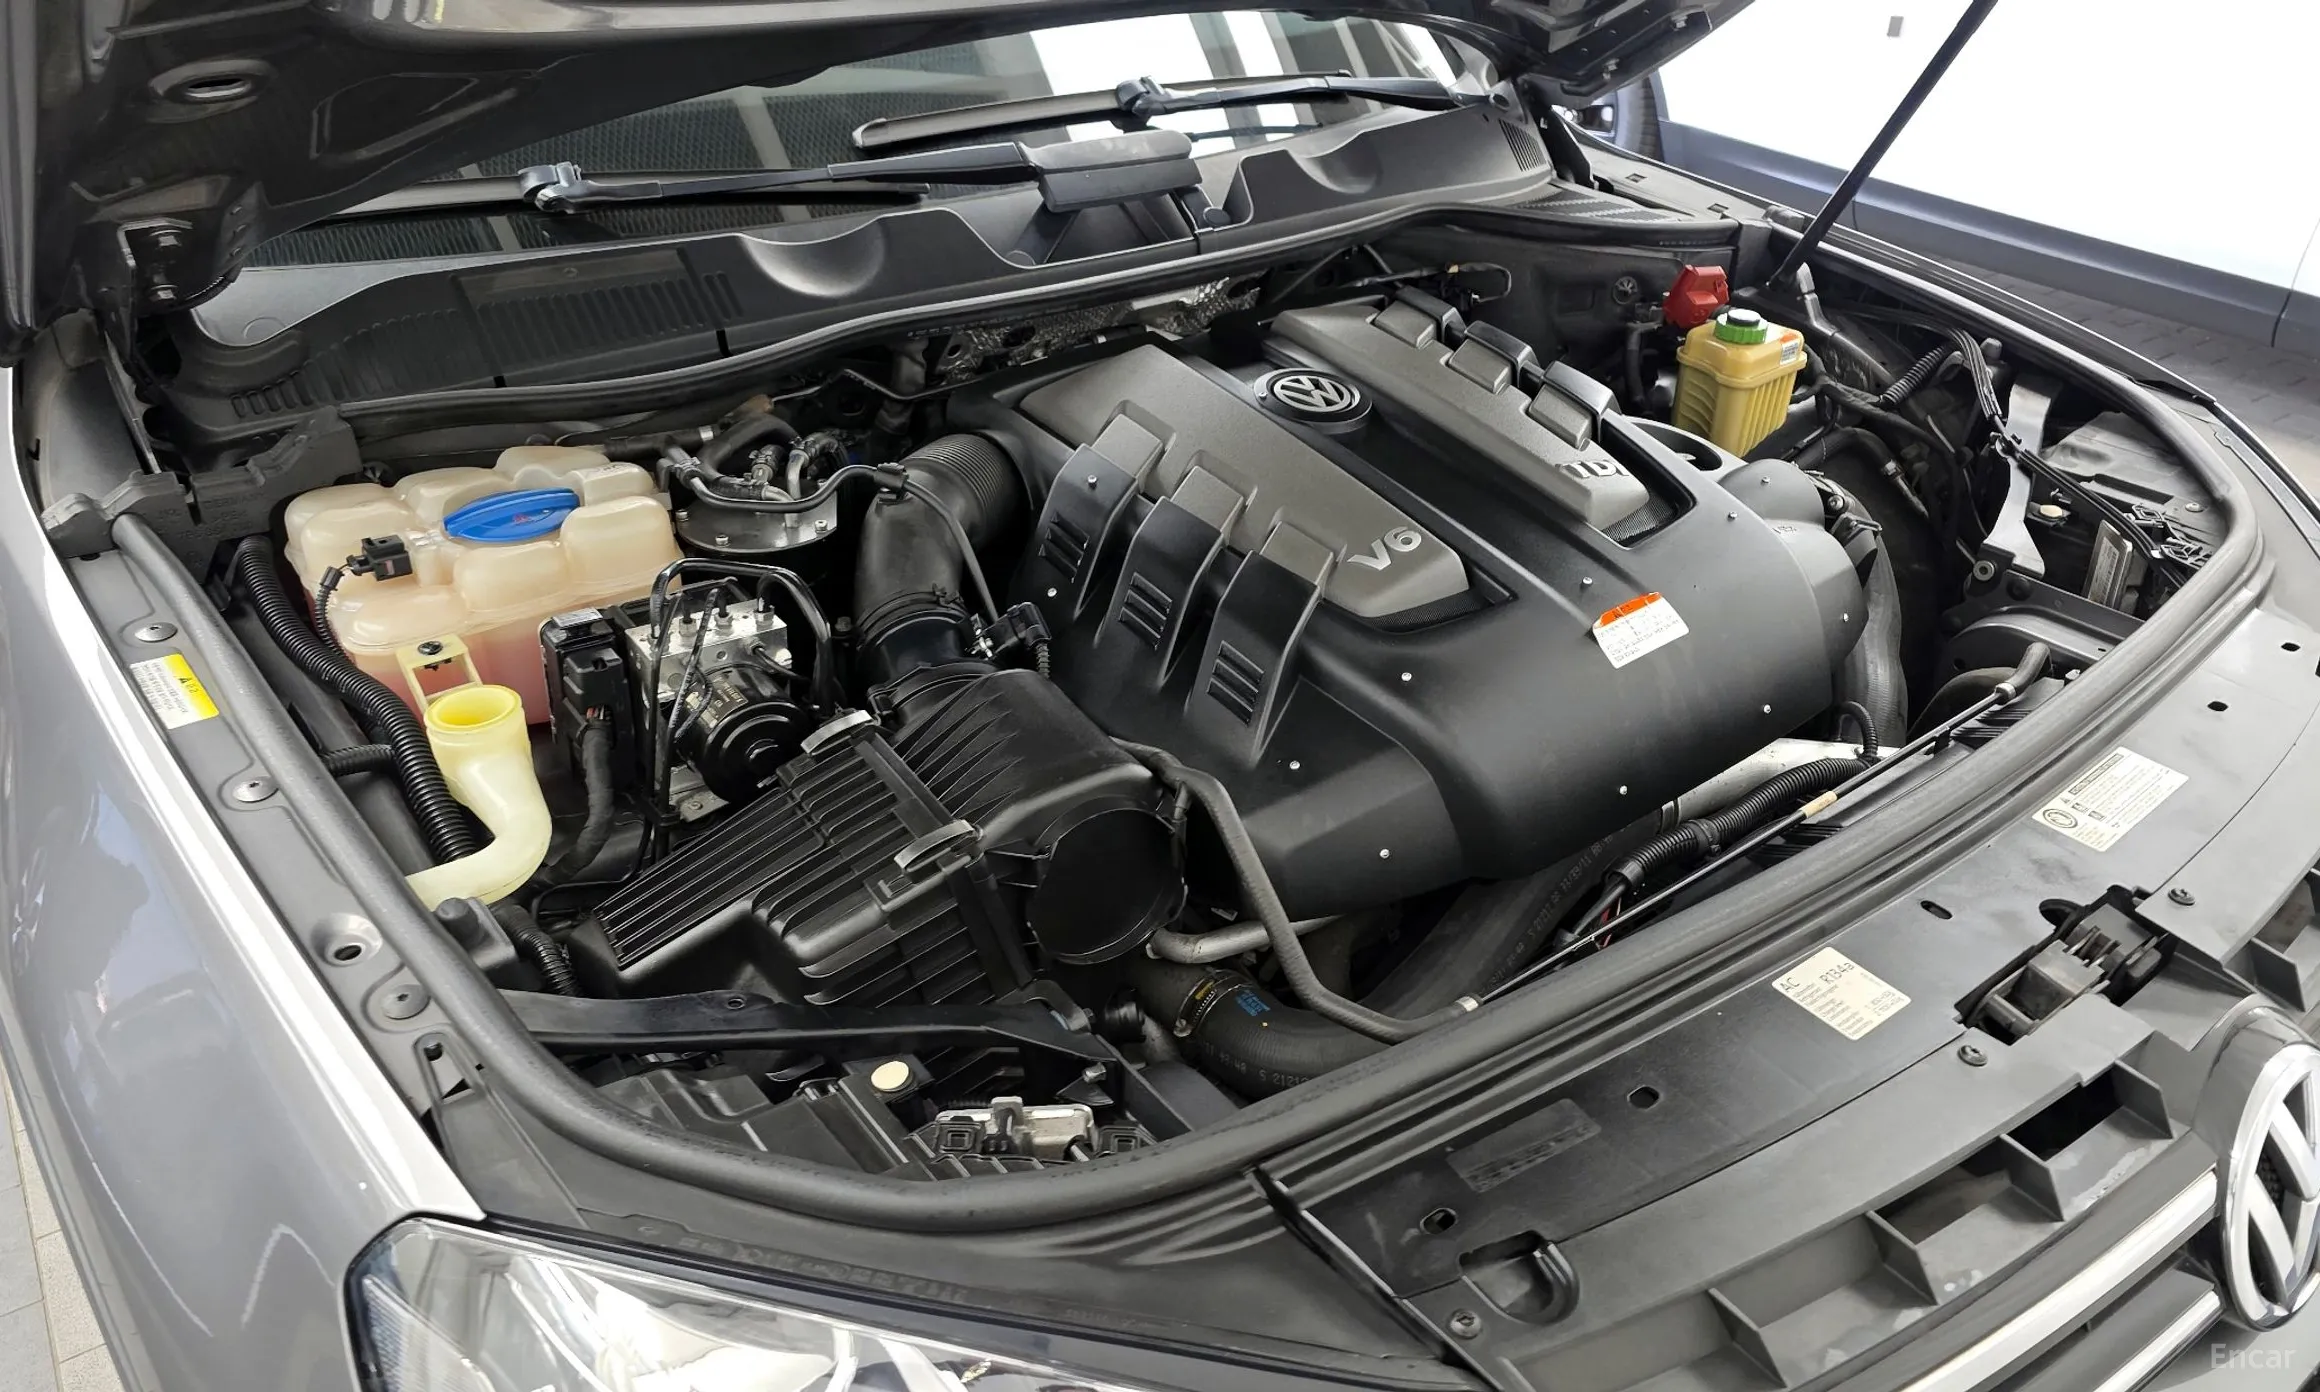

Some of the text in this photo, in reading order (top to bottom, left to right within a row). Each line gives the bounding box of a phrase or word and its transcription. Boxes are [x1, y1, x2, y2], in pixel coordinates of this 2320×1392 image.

[1273, 375, 1351, 412] VW
[1346, 526, 1422, 571] V6
[1780, 977, 1801, 993] AC
[1819, 962, 1855, 984] R134a
